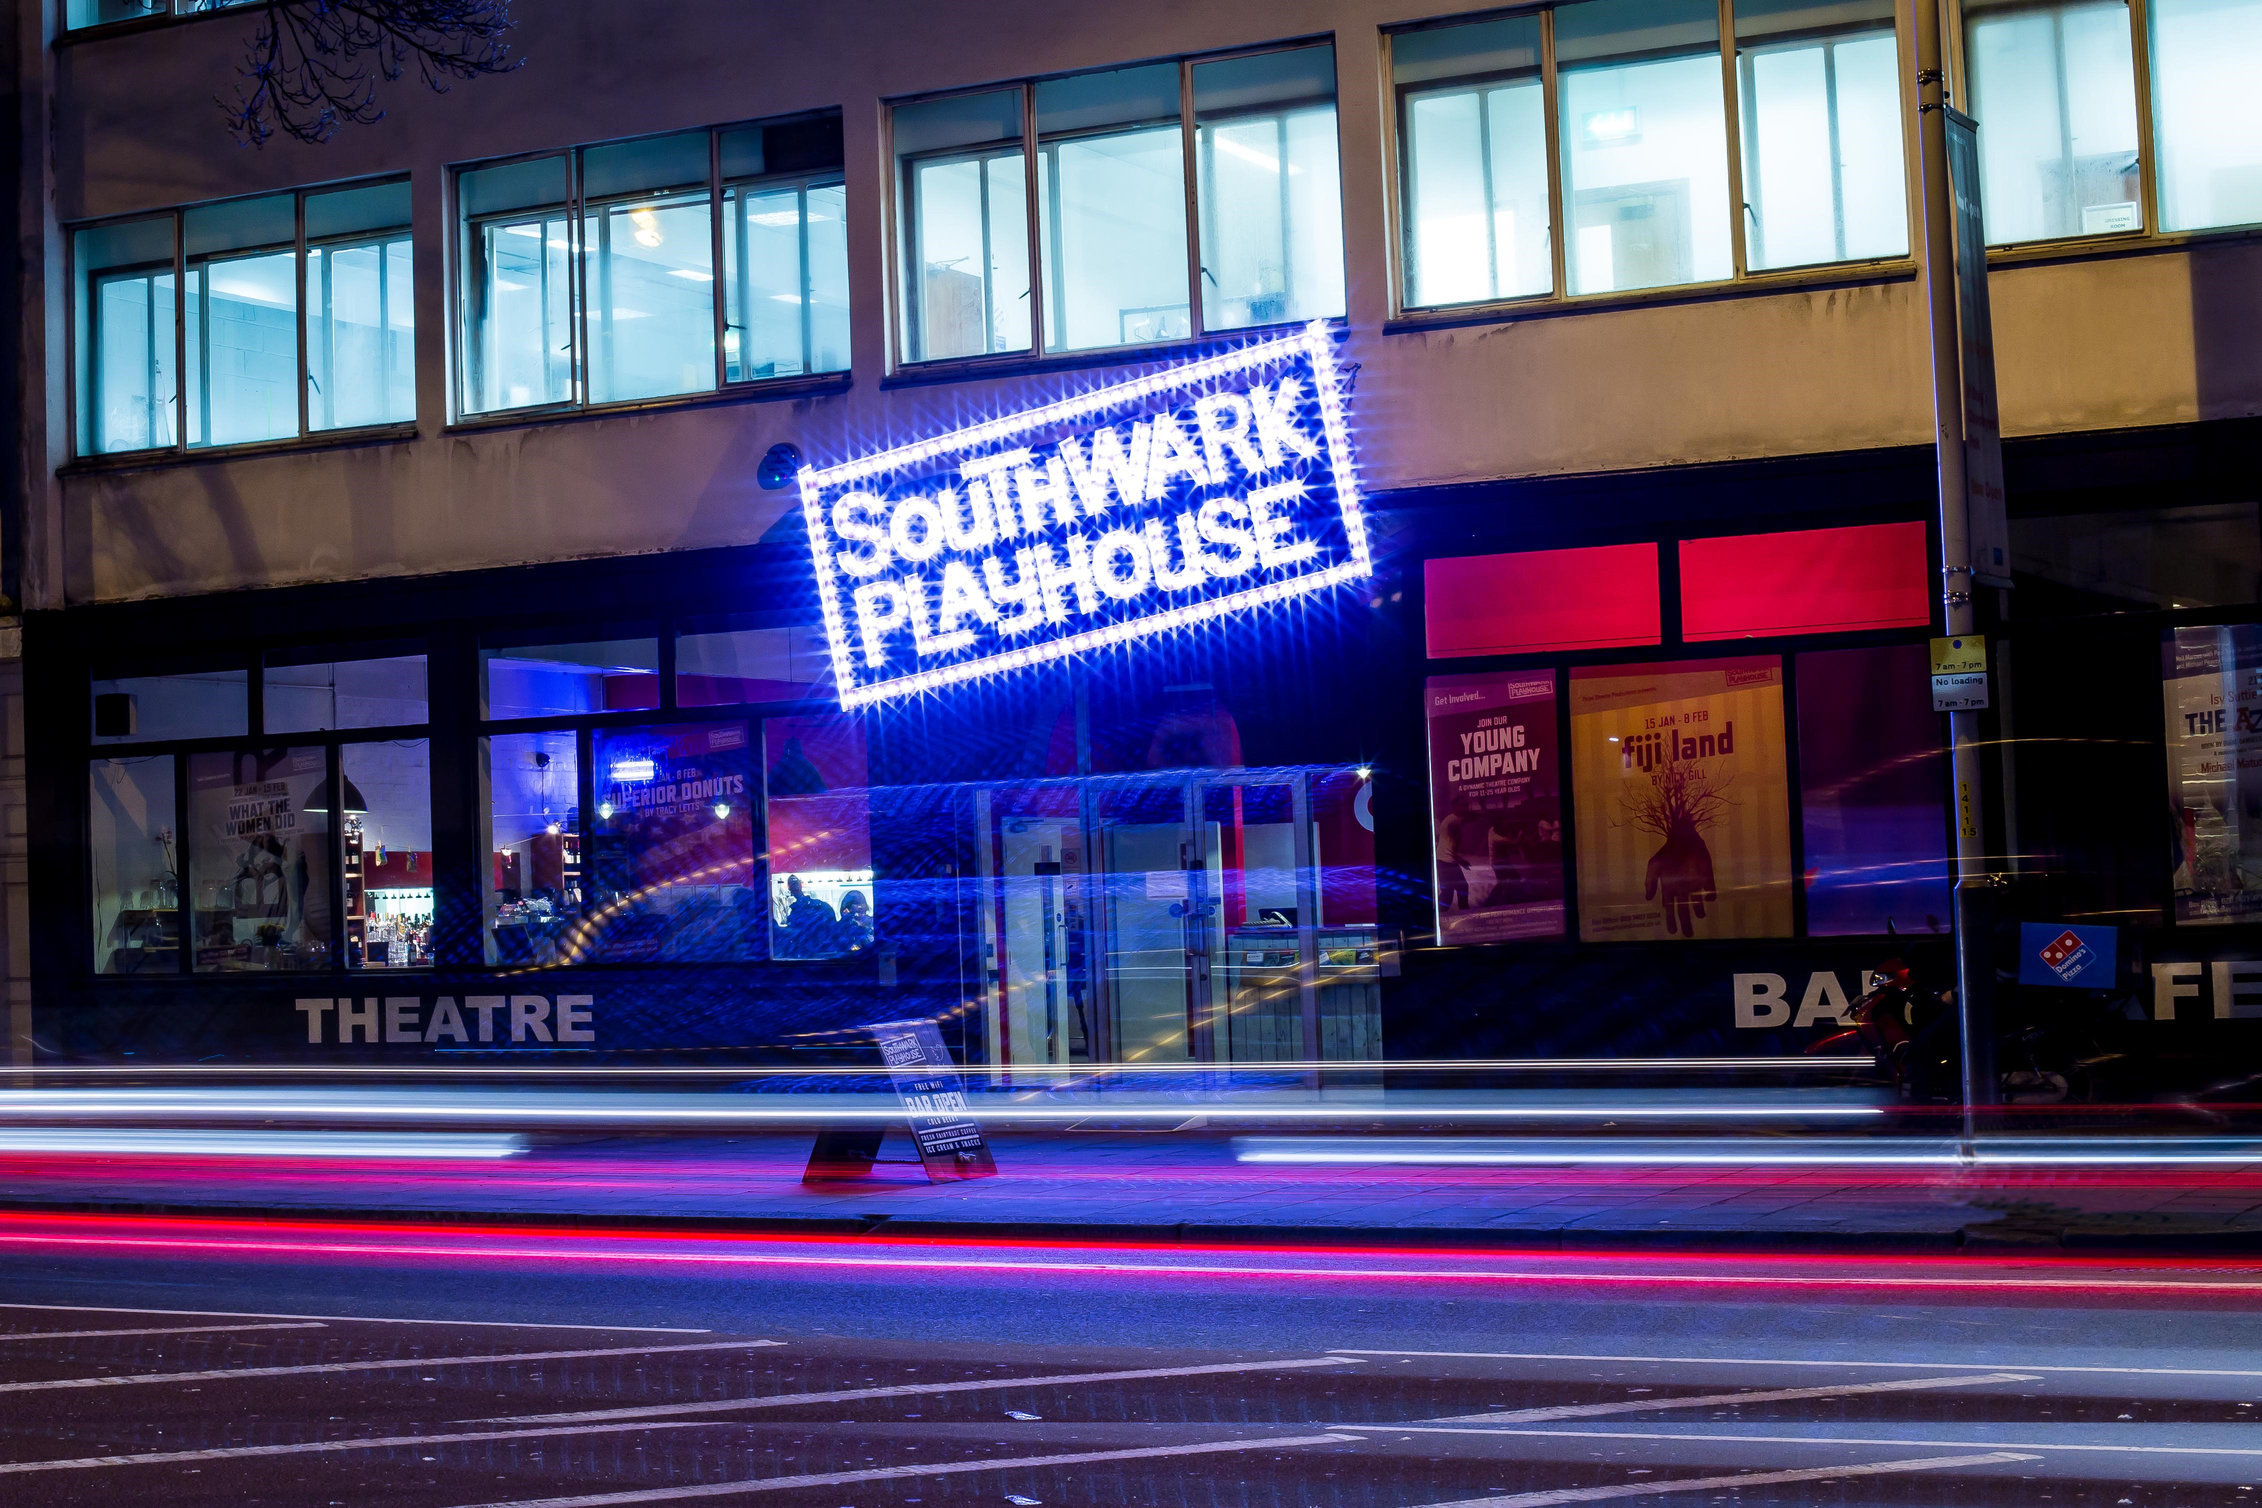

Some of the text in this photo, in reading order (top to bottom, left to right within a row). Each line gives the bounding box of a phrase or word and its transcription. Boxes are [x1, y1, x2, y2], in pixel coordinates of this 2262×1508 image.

[832, 376, 1318, 577] SOUTHWARK
[854, 481, 1318, 668] PLAYHOUSE
[1961, 661, 1967, 669] 7
[1935, 676, 1984, 686] No loading
[1434, 696, 1448, 706] Get
[1938, 700, 1943, 708] 7
[1964, 698, 1969, 706] 7
[1477, 715, 1507, 728] JOIN OUR
[1645, 718, 1655, 730] 15
[1658, 715, 1675, 728] JAN
[1683, 713, 1690, 724] 8
[1692, 710, 1708, 722] FEB
[2185, 709, 2227, 735] THE
[1460, 725, 1525, 755] YOUNG
[1621, 721, 1734, 773] fiji land
[683, 767, 696, 779] FEB
[1447, 747, 1541, 782] COMPANY
[1652, 769, 1707, 786] BY NICK GILL
[245, 784, 258, 795] JAN
[273, 782, 285, 792] FEB
[601, 774, 744, 810] SUPERIOR DONUTS
[229, 801, 265, 820] WHAT
[268, 797, 291, 815] THE
[645, 802, 700, 818] BY TRACY LETTS
[226, 812, 295, 836] WOMEN DID
[2055, 948, 2086, 974] Domino's
[2062, 964, 2081, 980] Pizza
[2150, 961, 2262, 1020] FE
[296, 995, 594, 1043] THEATRE
[883, 1038, 919, 1056] SOUTHWARK
[888, 1048, 922, 1065] PLAYHOUSE
[914, 1082, 929, 1091] FREE
[905, 1090, 968, 1118] BAR OPEN
[925, 1145, 936, 1154] ICE
[936, 1142, 954, 1152] CREAM
[961, 1138, 981, 1148] SNACKS
